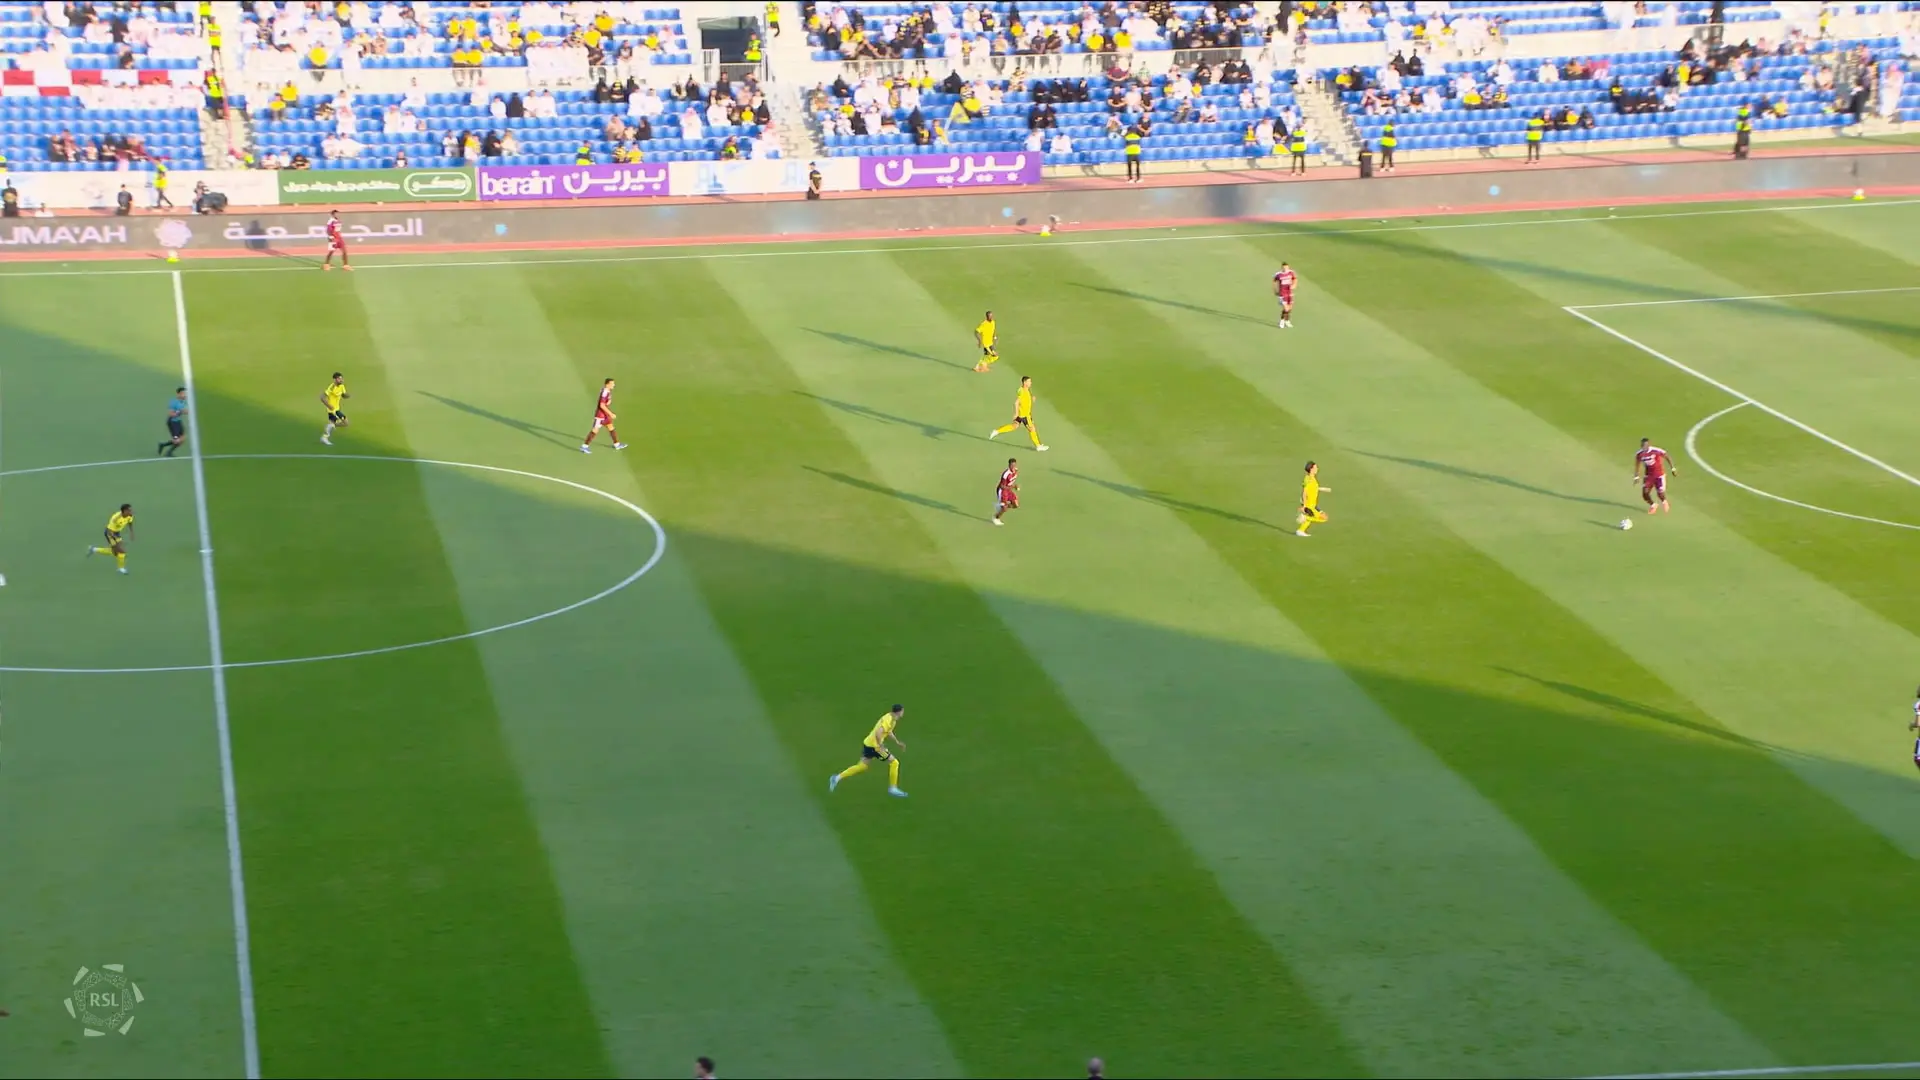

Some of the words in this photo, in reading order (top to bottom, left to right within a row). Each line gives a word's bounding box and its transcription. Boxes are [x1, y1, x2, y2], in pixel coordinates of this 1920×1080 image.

[481, 170, 555, 195] berain
[563, 169, 666, 194] بيرين
[875, 154, 1026, 187] بيرين
[0, 225, 127, 245] JMA'AH
